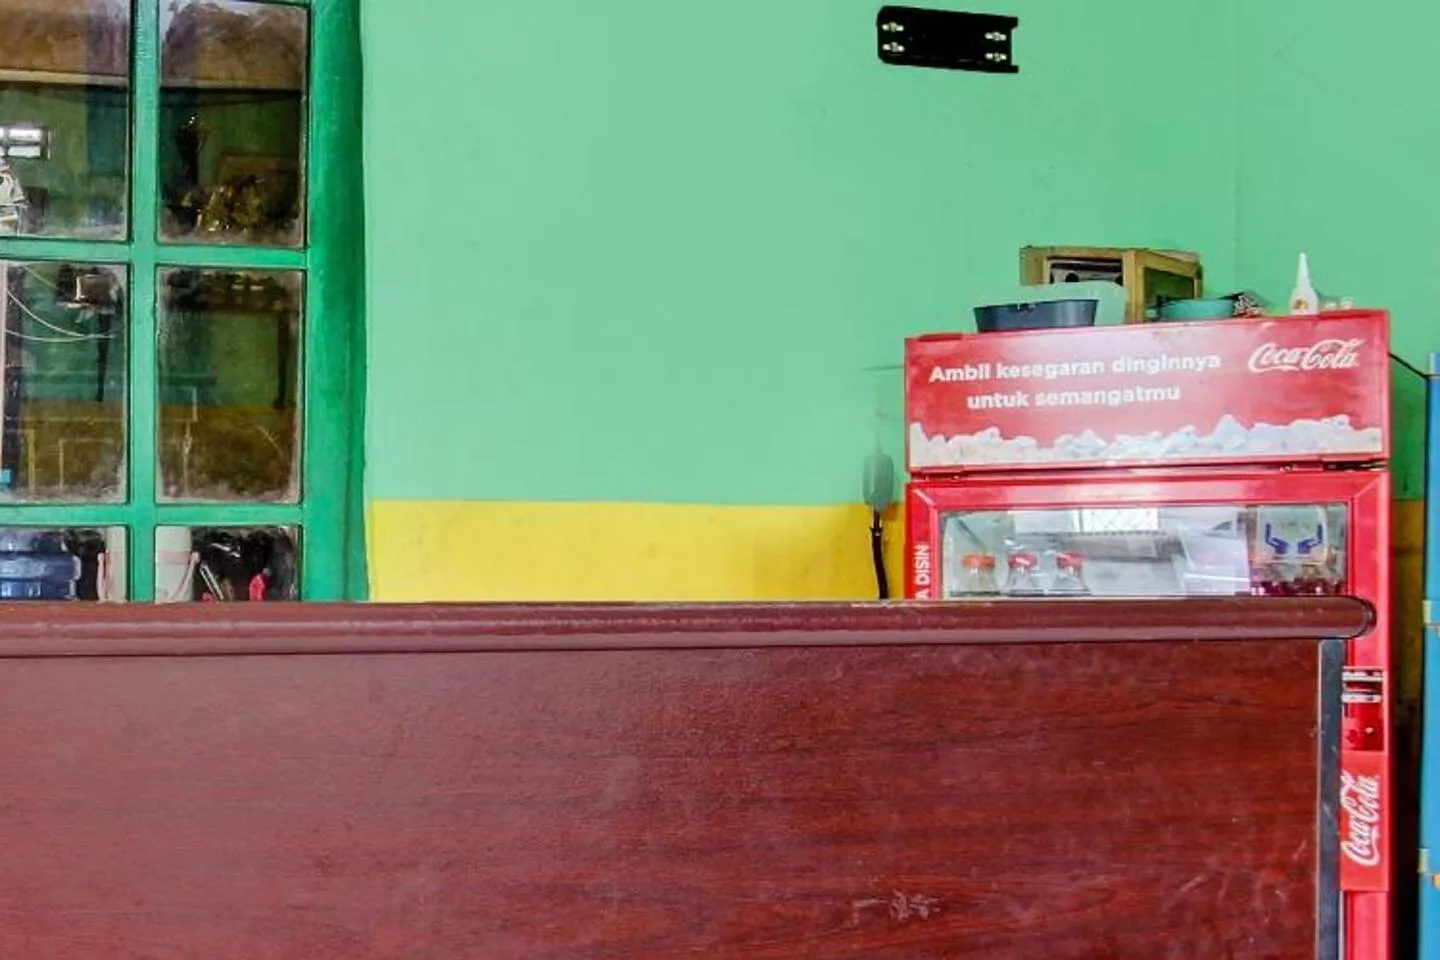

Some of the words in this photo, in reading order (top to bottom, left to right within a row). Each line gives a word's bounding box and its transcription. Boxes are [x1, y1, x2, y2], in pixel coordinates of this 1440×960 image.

[929, 363, 991, 383] Ambil
[996, 359, 1105, 380] kesegaran
[1112, 353, 1222, 374] dinginnya
[1248, 338, 1365, 373] Coca-Cola
[967, 391, 1029, 410] untuk
[1035, 385, 1181, 407] semangatmu
